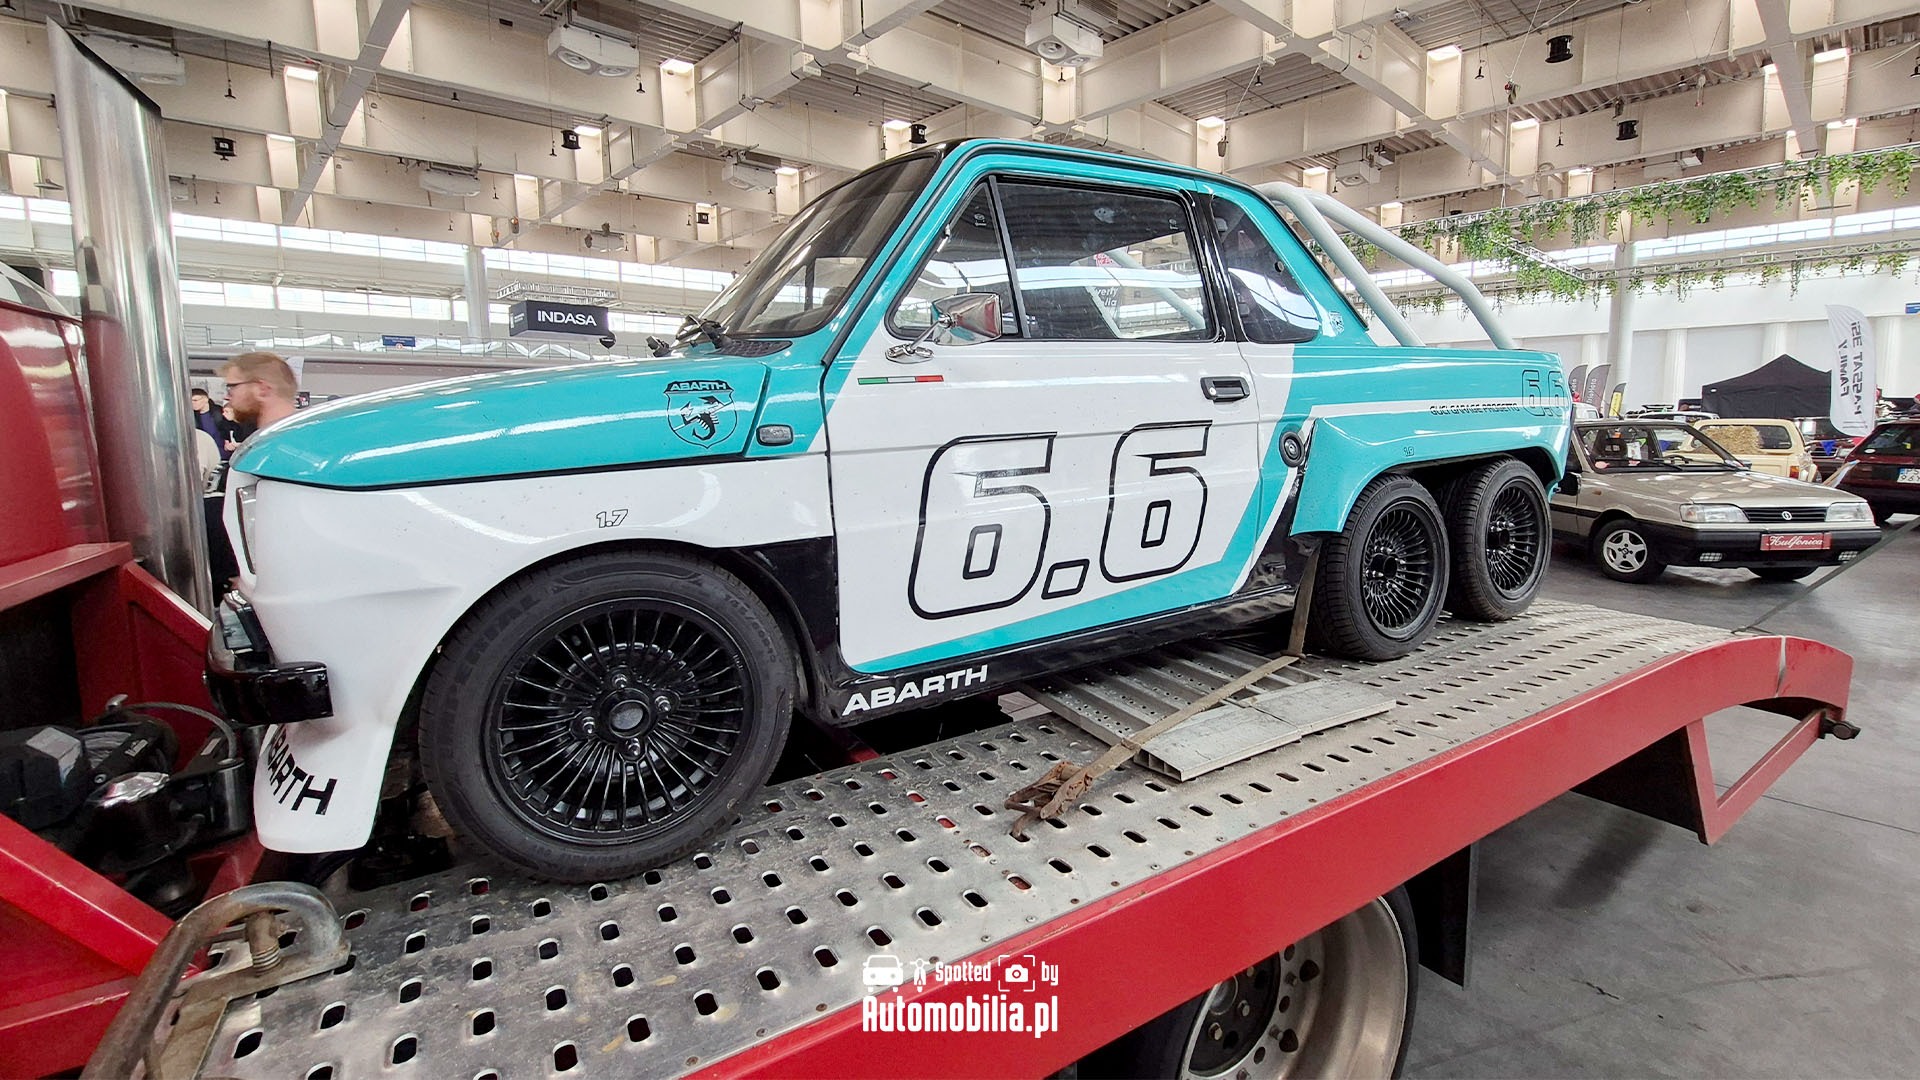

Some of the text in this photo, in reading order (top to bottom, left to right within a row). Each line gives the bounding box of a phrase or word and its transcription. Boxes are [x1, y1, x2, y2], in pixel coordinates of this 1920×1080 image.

[537, 310, 597, 326] INDASA
[670, 381, 727, 391] ABARTH
[1521, 369, 1565, 417] 6.6
[595, 508, 629, 529] 1.7
[907, 419, 1213, 620] 6.6
[841, 664, 988, 716] ABARTH
